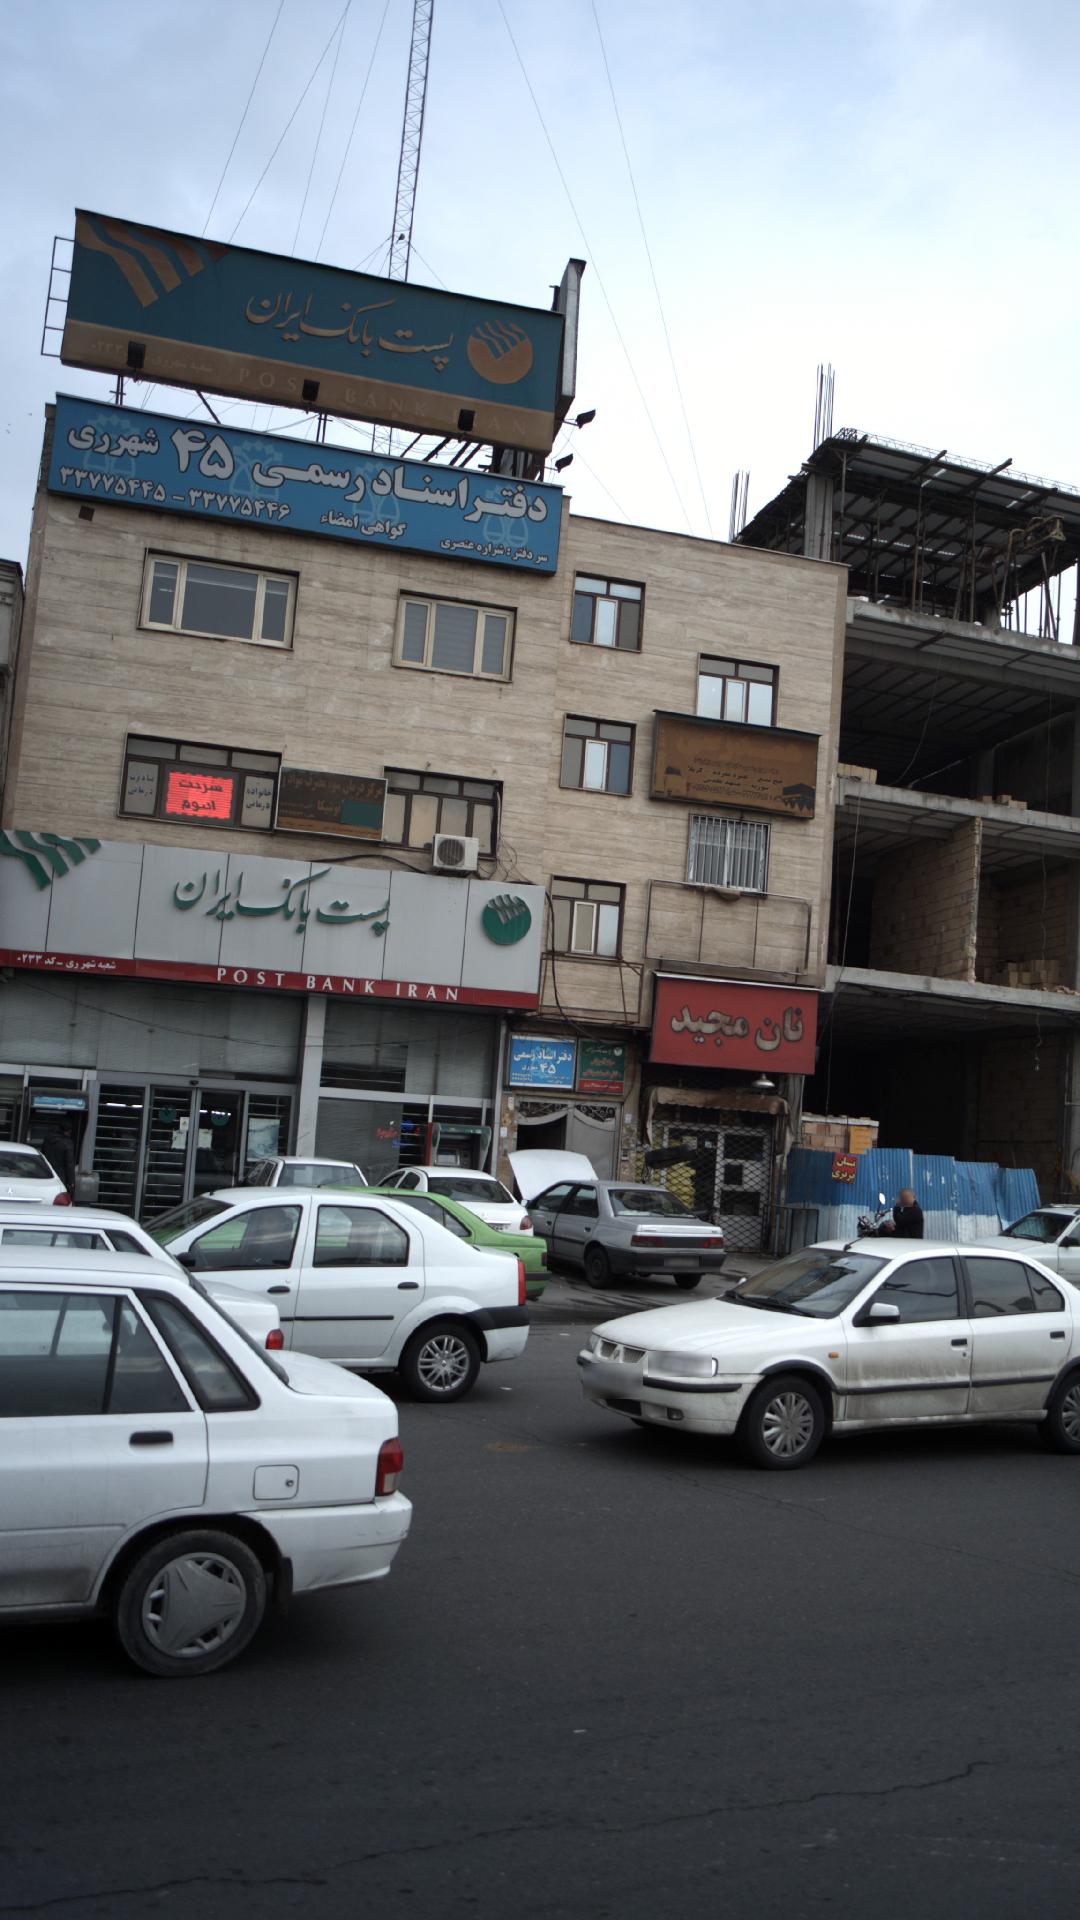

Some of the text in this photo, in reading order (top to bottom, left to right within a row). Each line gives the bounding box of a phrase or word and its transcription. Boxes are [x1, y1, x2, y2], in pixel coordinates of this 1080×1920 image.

[245, 293, 313, 342] ایران
[377, 328, 454, 373] پست
[169, 427, 235, 481] ۴۵
[251, 460, 366, 502] رسمی
[371, 464, 470, 511] اسناد
[463, 483, 549, 523] دفتر
[319, 510, 408, 541] گواهی امضاء
[173, 866, 392, 938] پست بانک ایران
[216, 966, 460, 1002] POST BANK IRAN
[670, 1003, 804, 1051] نان مجید
[831, 1169, 856, 1183] بربری
[835, 1155, 857, 1168] نان
